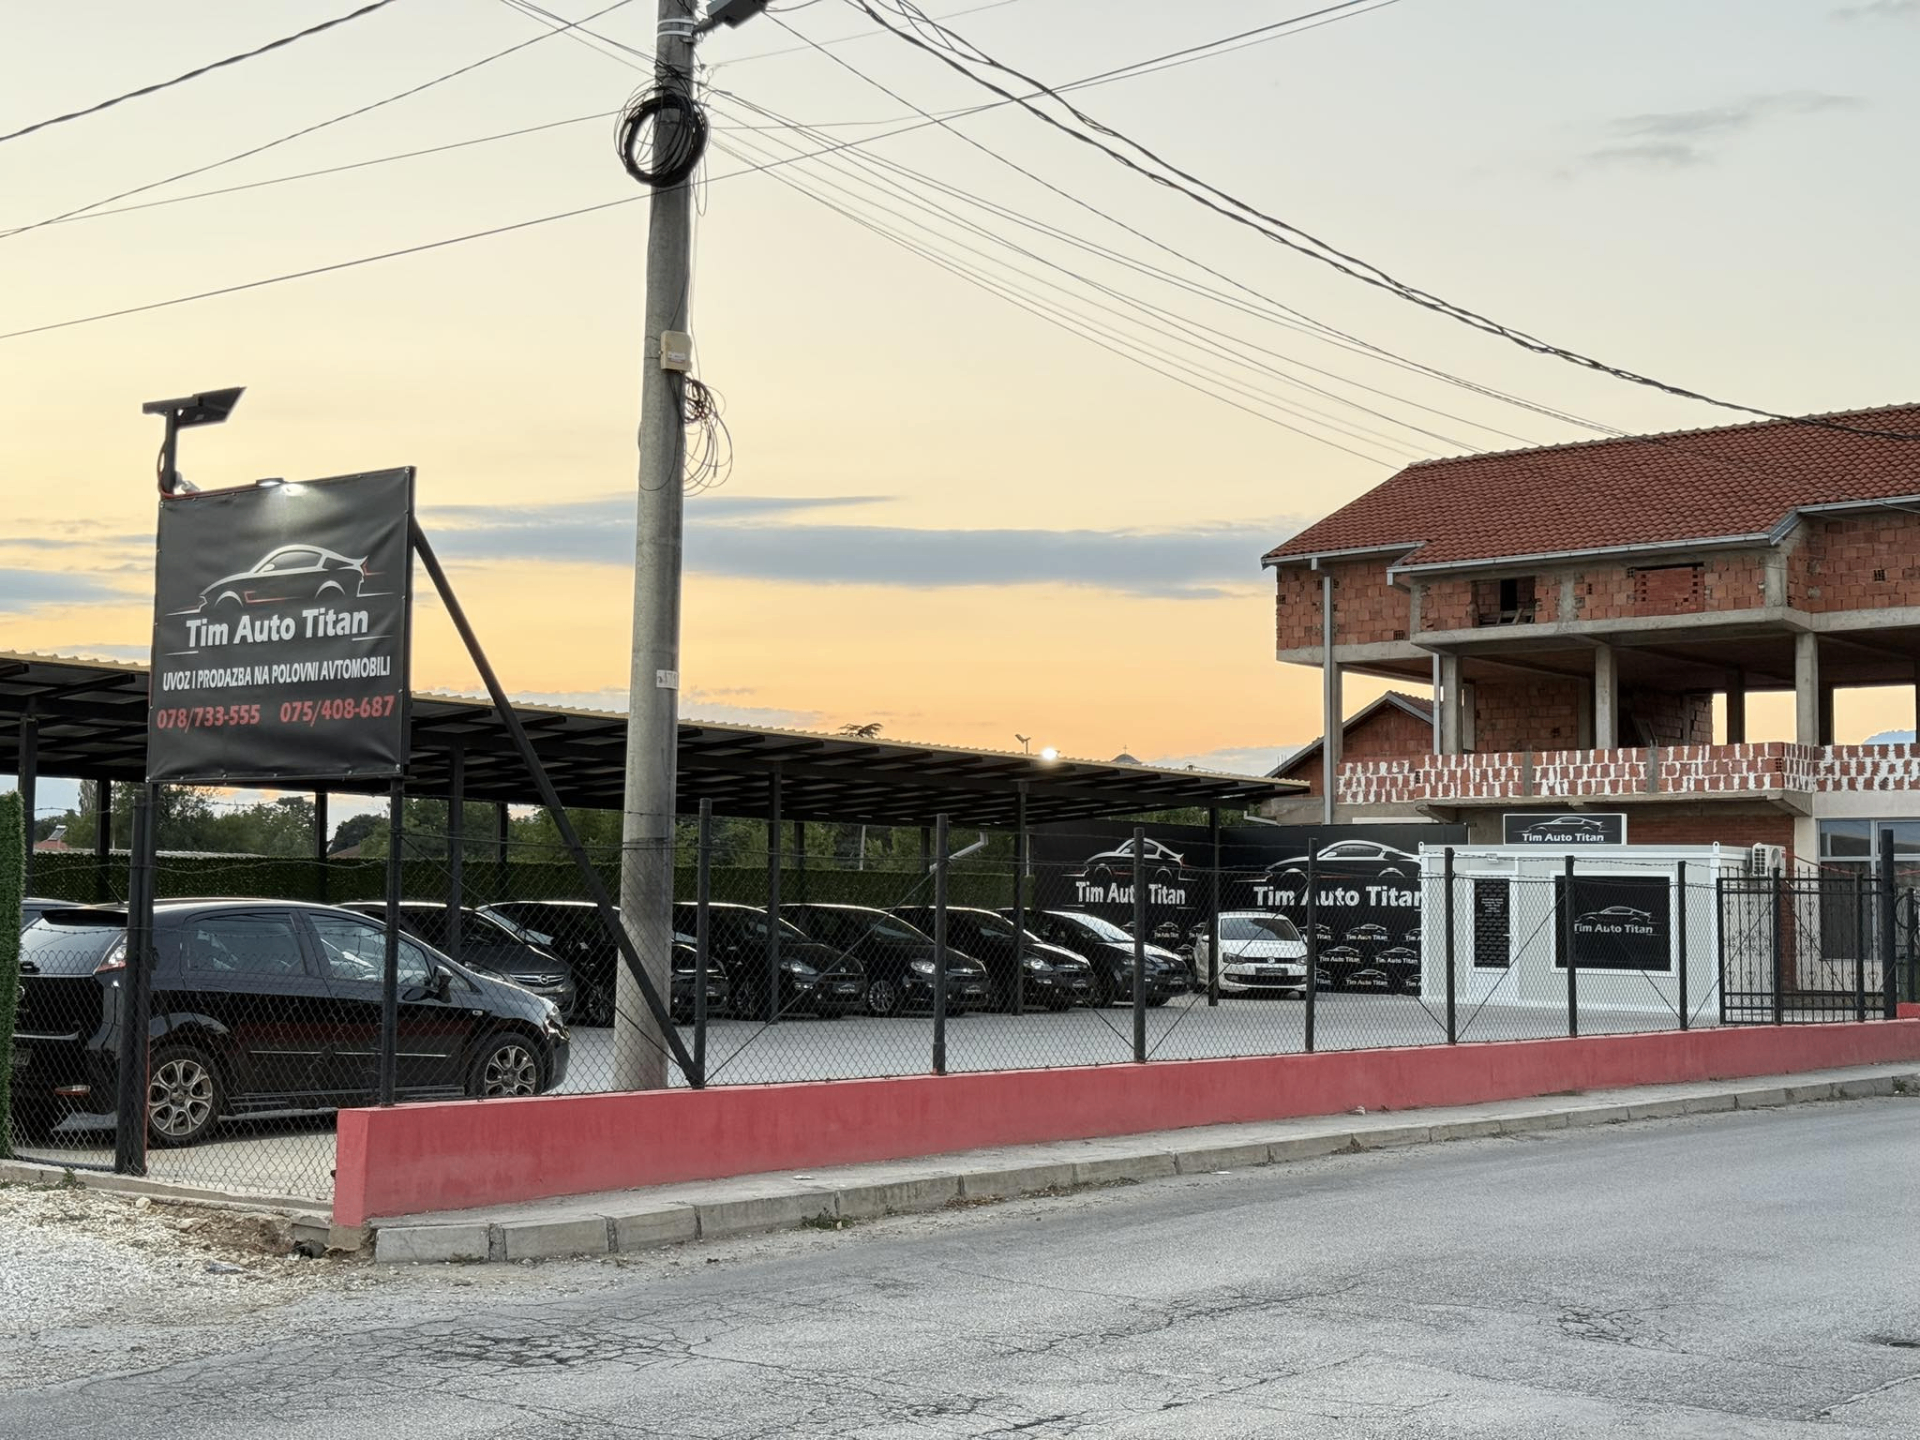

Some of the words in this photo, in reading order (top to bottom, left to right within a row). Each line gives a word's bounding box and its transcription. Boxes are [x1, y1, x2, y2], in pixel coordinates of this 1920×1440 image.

[186, 618, 228, 648] Tim
[233, 614, 296, 644] Auto
[302, 607, 368, 639] Titan
[163, 671, 191, 691] UVOZ
[192, 671, 196, 689] I
[197, 666, 252, 689] PRODAZBA
[253, 666, 270, 685] NA
[271, 661, 319, 684] POLOVNI
[320, 656, 391, 680] AVTOMOBILI
[157, 704, 261, 733] 078/733-555
[279, 695, 395, 727] 075/408-687
[1522, 833, 1542, 842] Tim
[1544, 833, 1572, 842] Auto
[1575, 832, 1604, 842] Titan
[1075, 881, 1104, 902] Tim
[1106, 882, 1136, 904] Aut
[1148, 884, 1185, 905] Titan
[1253, 886, 1295, 906] Tim
[1574, 923, 1592, 932] Tim
[1594, 924, 1622, 933] Auto
[1624, 924, 1653, 934] Titan
